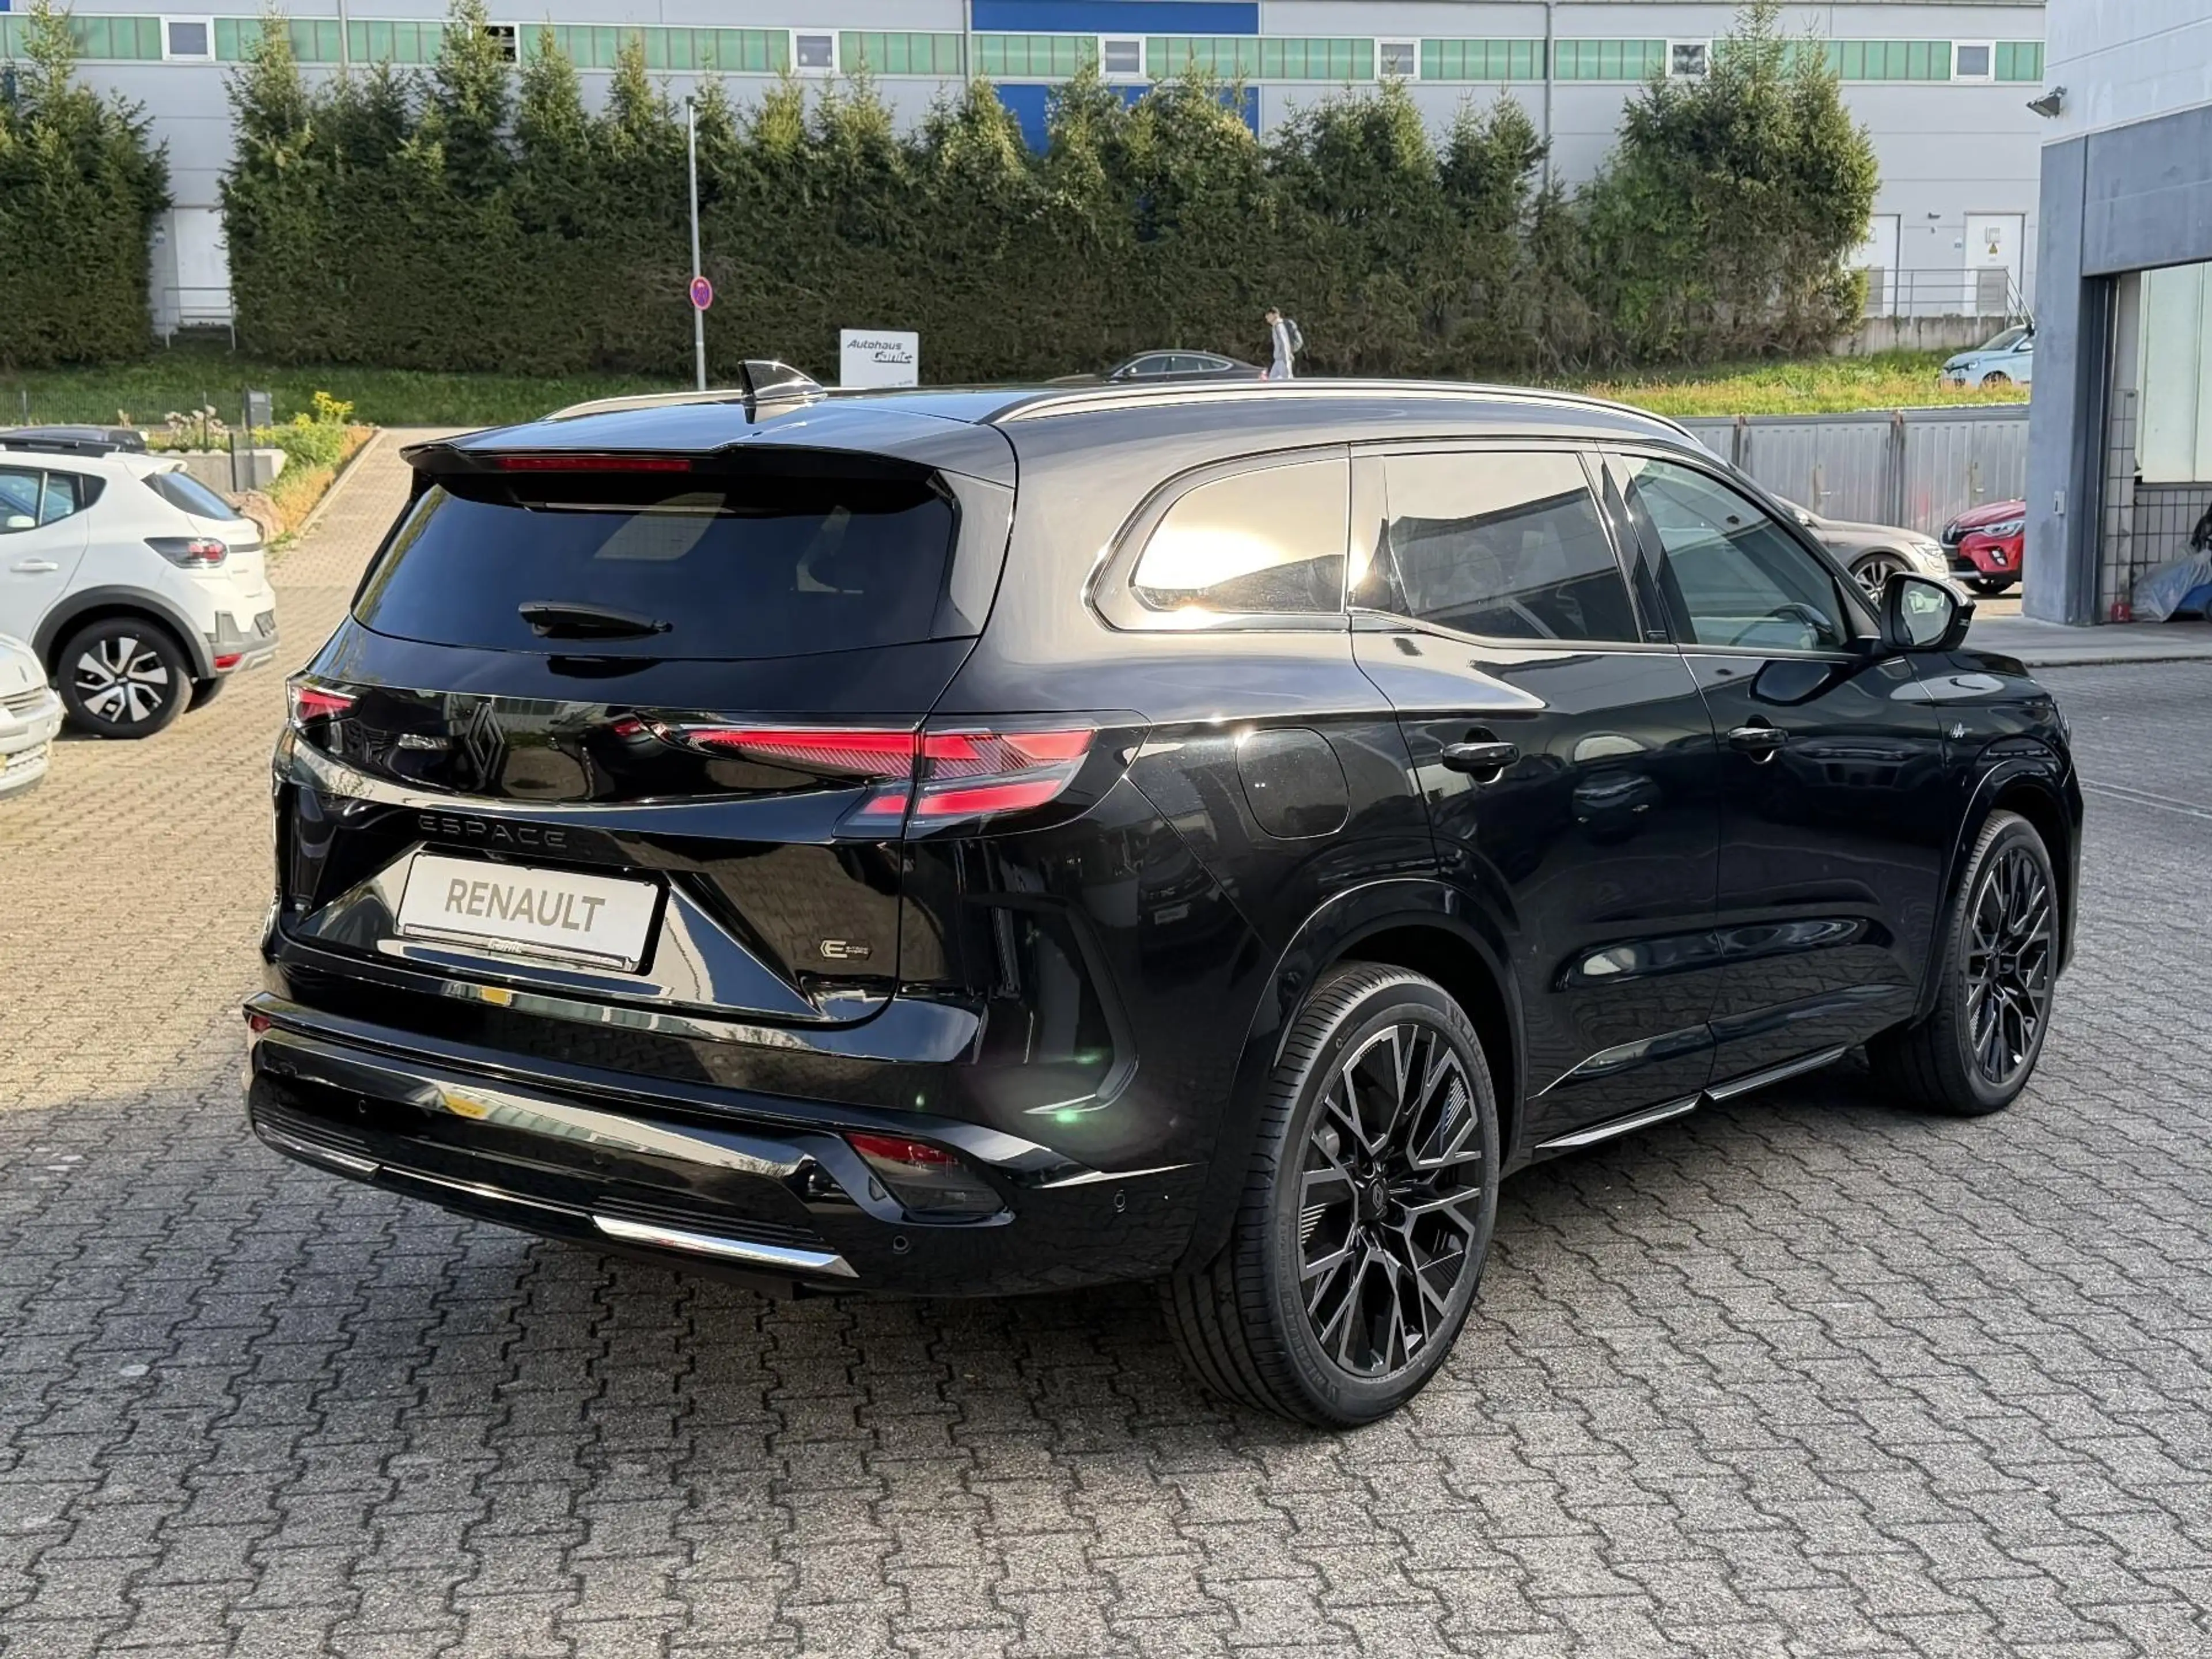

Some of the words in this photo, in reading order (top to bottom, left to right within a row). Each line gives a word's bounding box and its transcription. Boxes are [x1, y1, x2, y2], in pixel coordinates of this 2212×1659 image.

[847, 339, 904, 350] Autohaus
[416, 814, 568, 849] ESPACE
[444, 878, 606, 933] RENAULT
